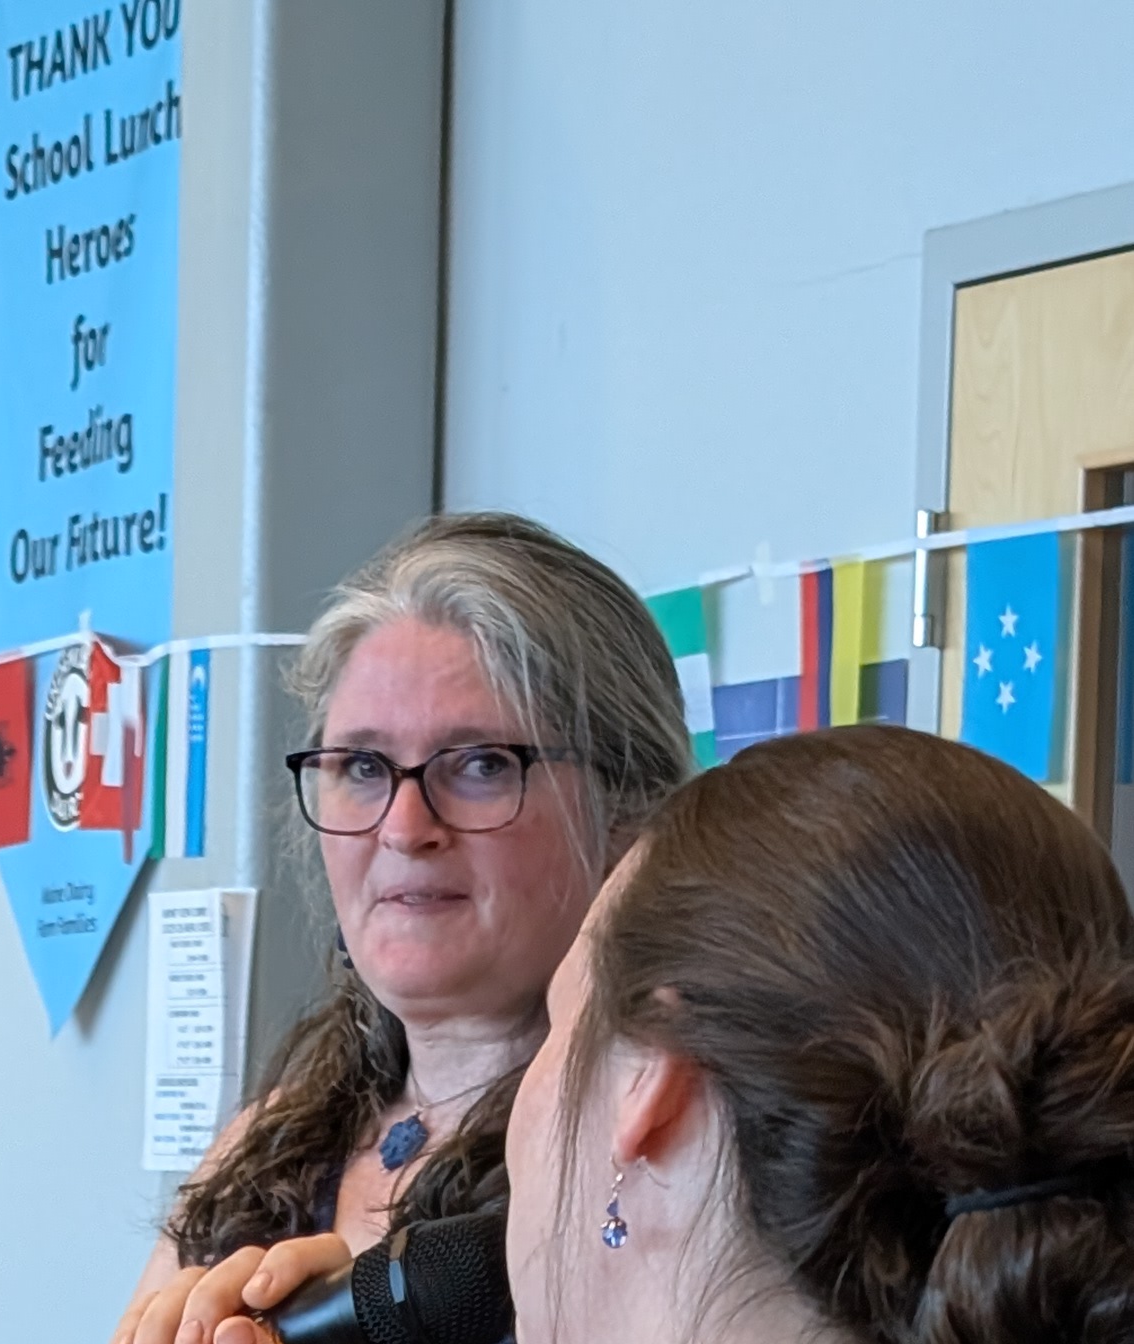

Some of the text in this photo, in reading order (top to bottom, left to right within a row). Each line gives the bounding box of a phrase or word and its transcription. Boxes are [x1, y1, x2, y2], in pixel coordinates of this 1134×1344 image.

[8, 9, 112, 101] THANK
[4, 80, 182, 201] School Lunch
[45, 214, 137, 285] Heroes
[70, 314, 110, 391] for
[38, 403, 134, 483] Feeding
[10, 492, 168, 585] Our Future!
